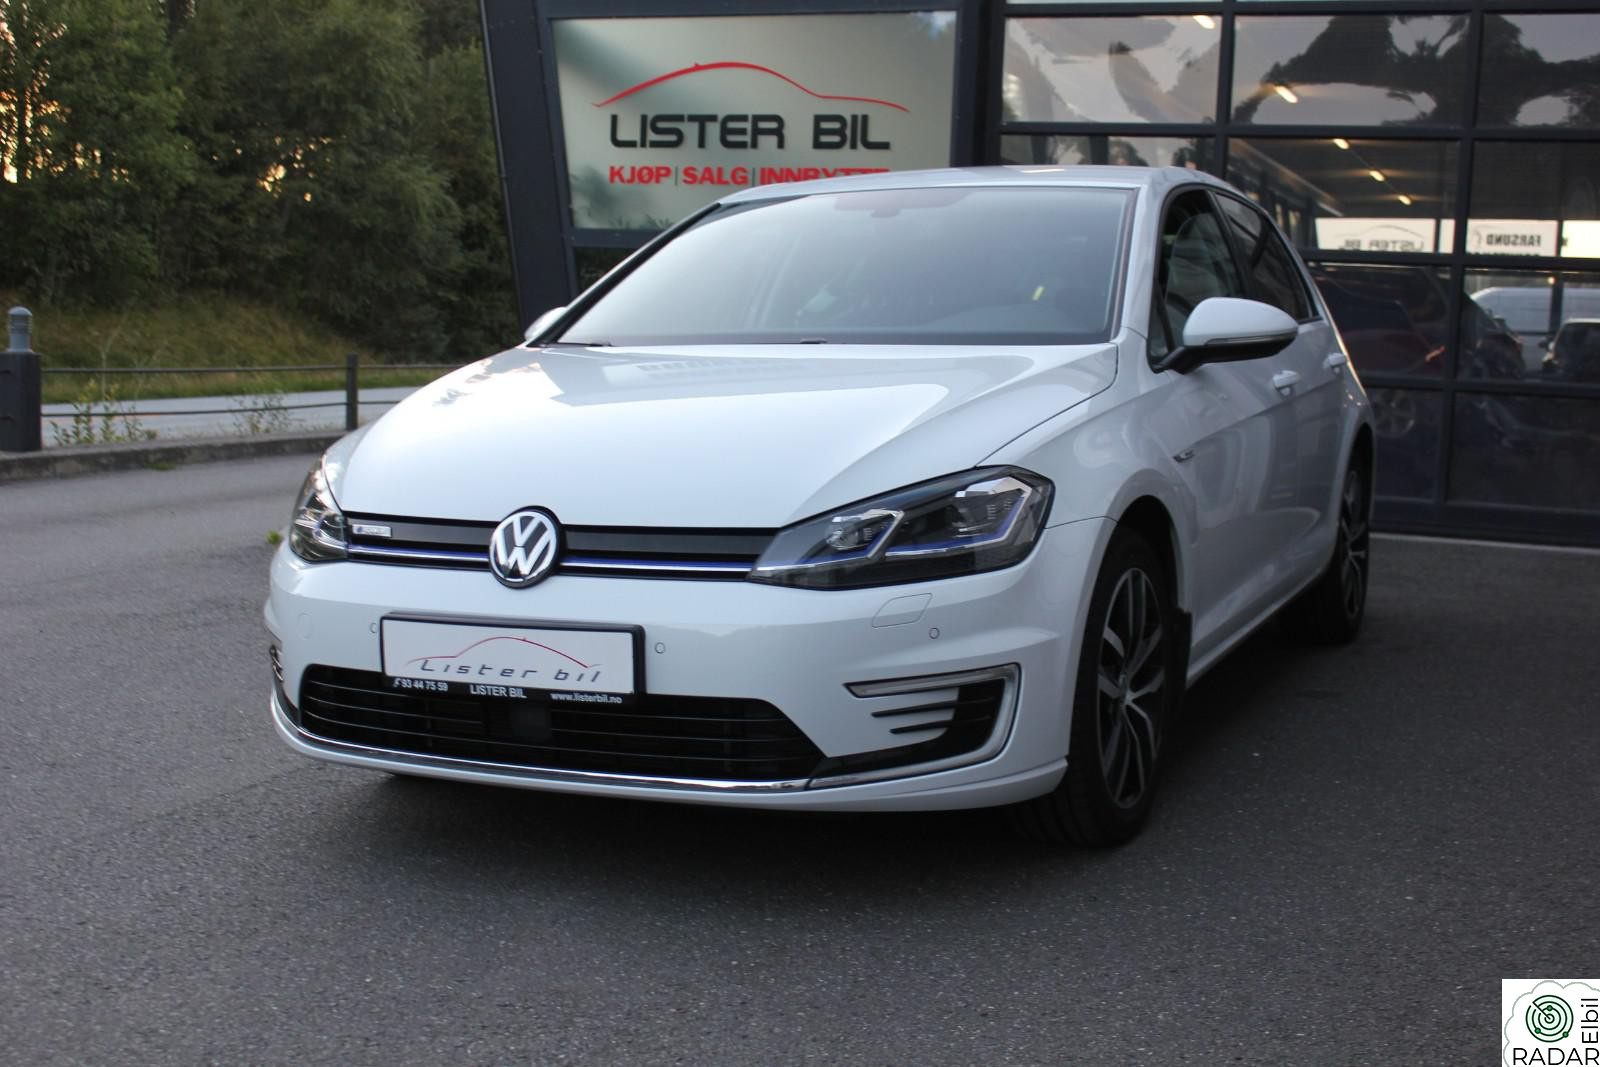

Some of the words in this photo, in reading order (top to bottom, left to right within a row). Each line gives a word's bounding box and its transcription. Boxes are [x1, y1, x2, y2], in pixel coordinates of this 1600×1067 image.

[610, 114, 785, 149] LISTER
[812, 114, 891, 150] BIL
[609, 166, 672, 184] KJØP
[682, 166, 750, 185] SALG
[420, 659, 537, 679] Lister
[553, 669, 600, 683] bil
[470, 684, 507, 697] LISTER
[509, 687, 527, 699] BIL
[550, 692, 623, 704] www.listerbil.no
